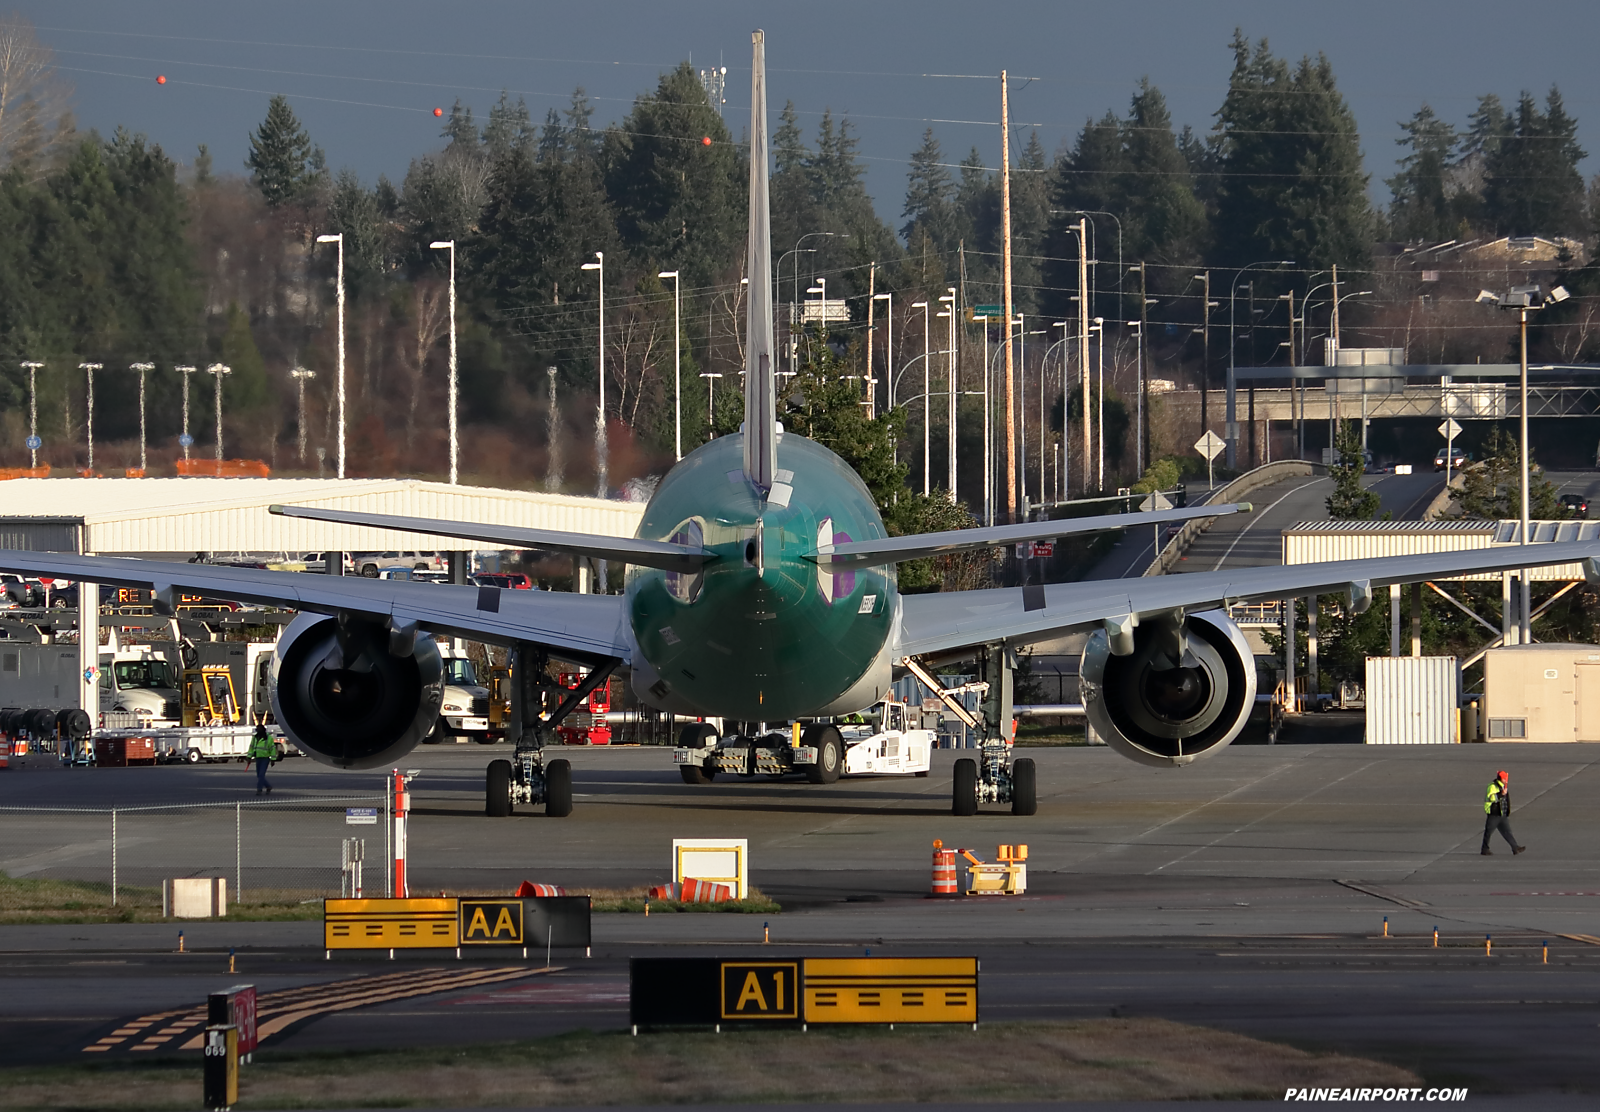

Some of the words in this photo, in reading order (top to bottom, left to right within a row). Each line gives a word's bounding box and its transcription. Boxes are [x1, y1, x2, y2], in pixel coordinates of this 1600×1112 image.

[20, 612, 44, 620] GLOBAL
[466, 907, 517, 937] AA
[736, 971, 784, 1010] A1
[205, 1045, 226, 1056] 069
